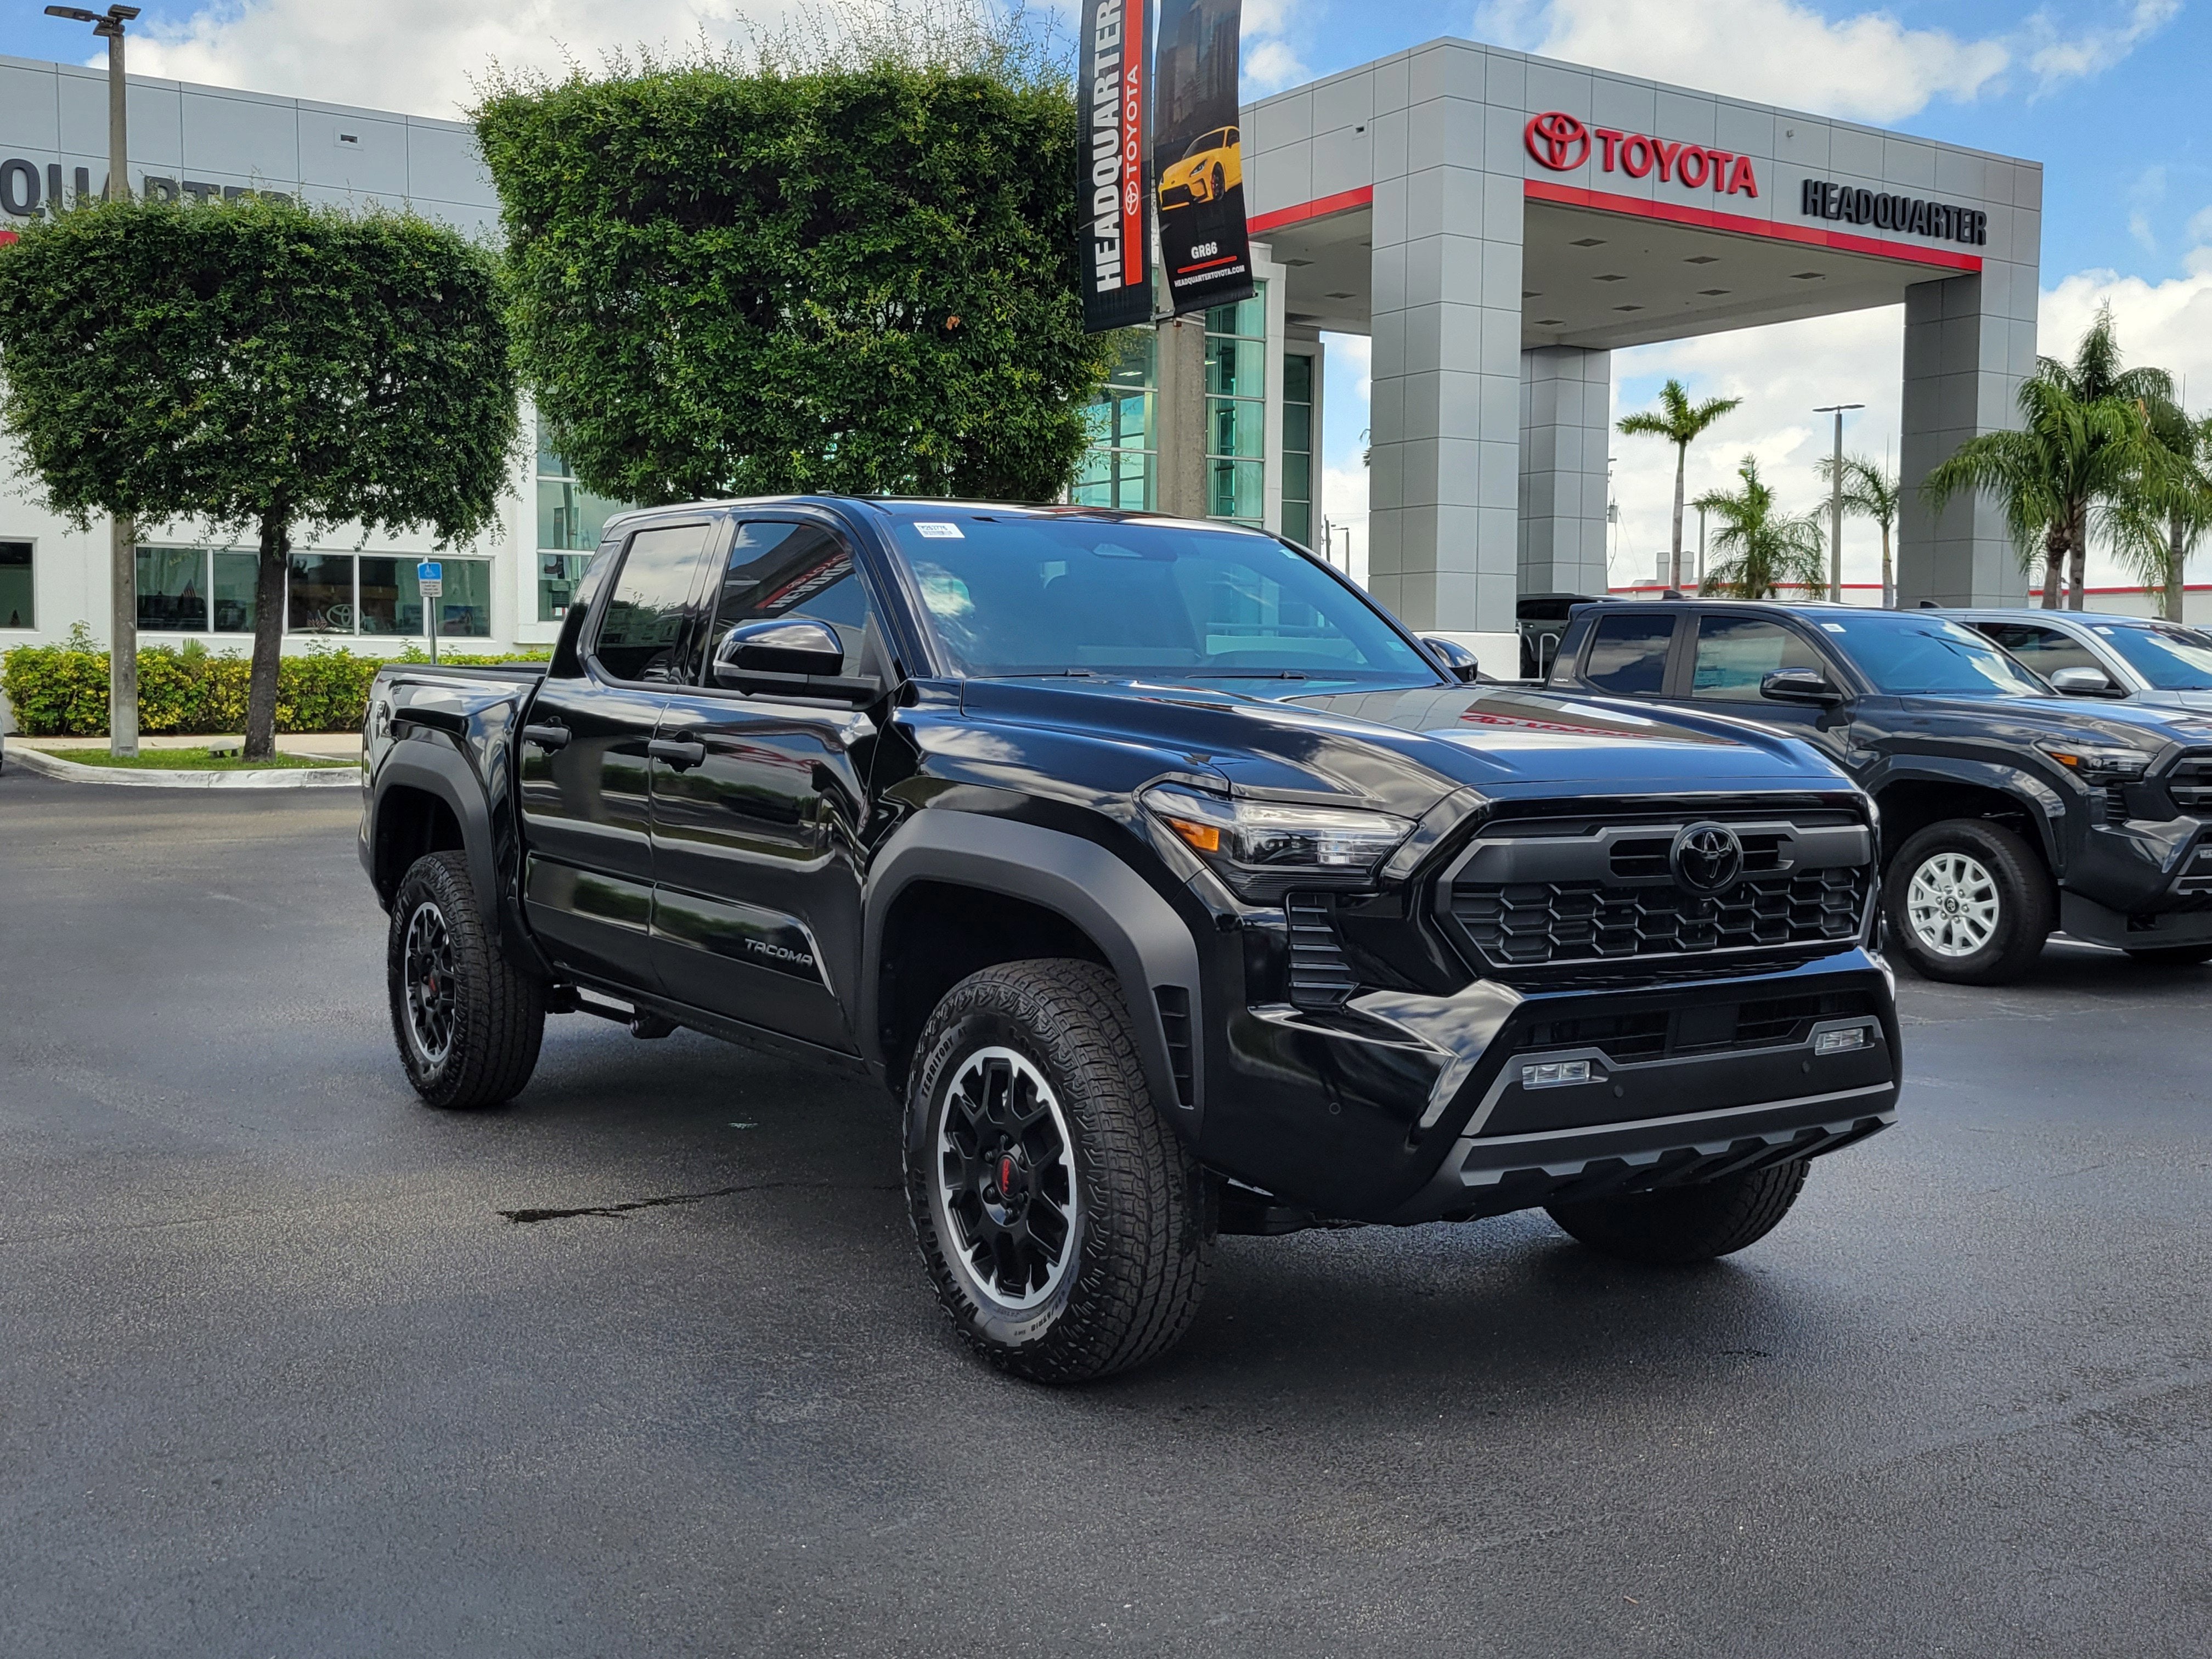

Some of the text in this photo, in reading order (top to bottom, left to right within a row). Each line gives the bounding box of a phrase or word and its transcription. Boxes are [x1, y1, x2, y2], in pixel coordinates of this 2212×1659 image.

[1093, 0, 1122, 292] HEADQUARTER
[1126, 64, 1138, 179] TOYOTA
[1595, 128, 1759, 198] TOYOTA
[1802, 179, 1987, 245] HEADQUARTER
[1174, 265, 1245, 287] HEADQUARTERTOYOTA.COM
[1191, 241, 1218, 259] GR86
[744, 938, 813, 967] TACOMA
[922, 1035, 953, 1098] TERRITORY
[912, 1167, 980, 1323] WRANGLER
